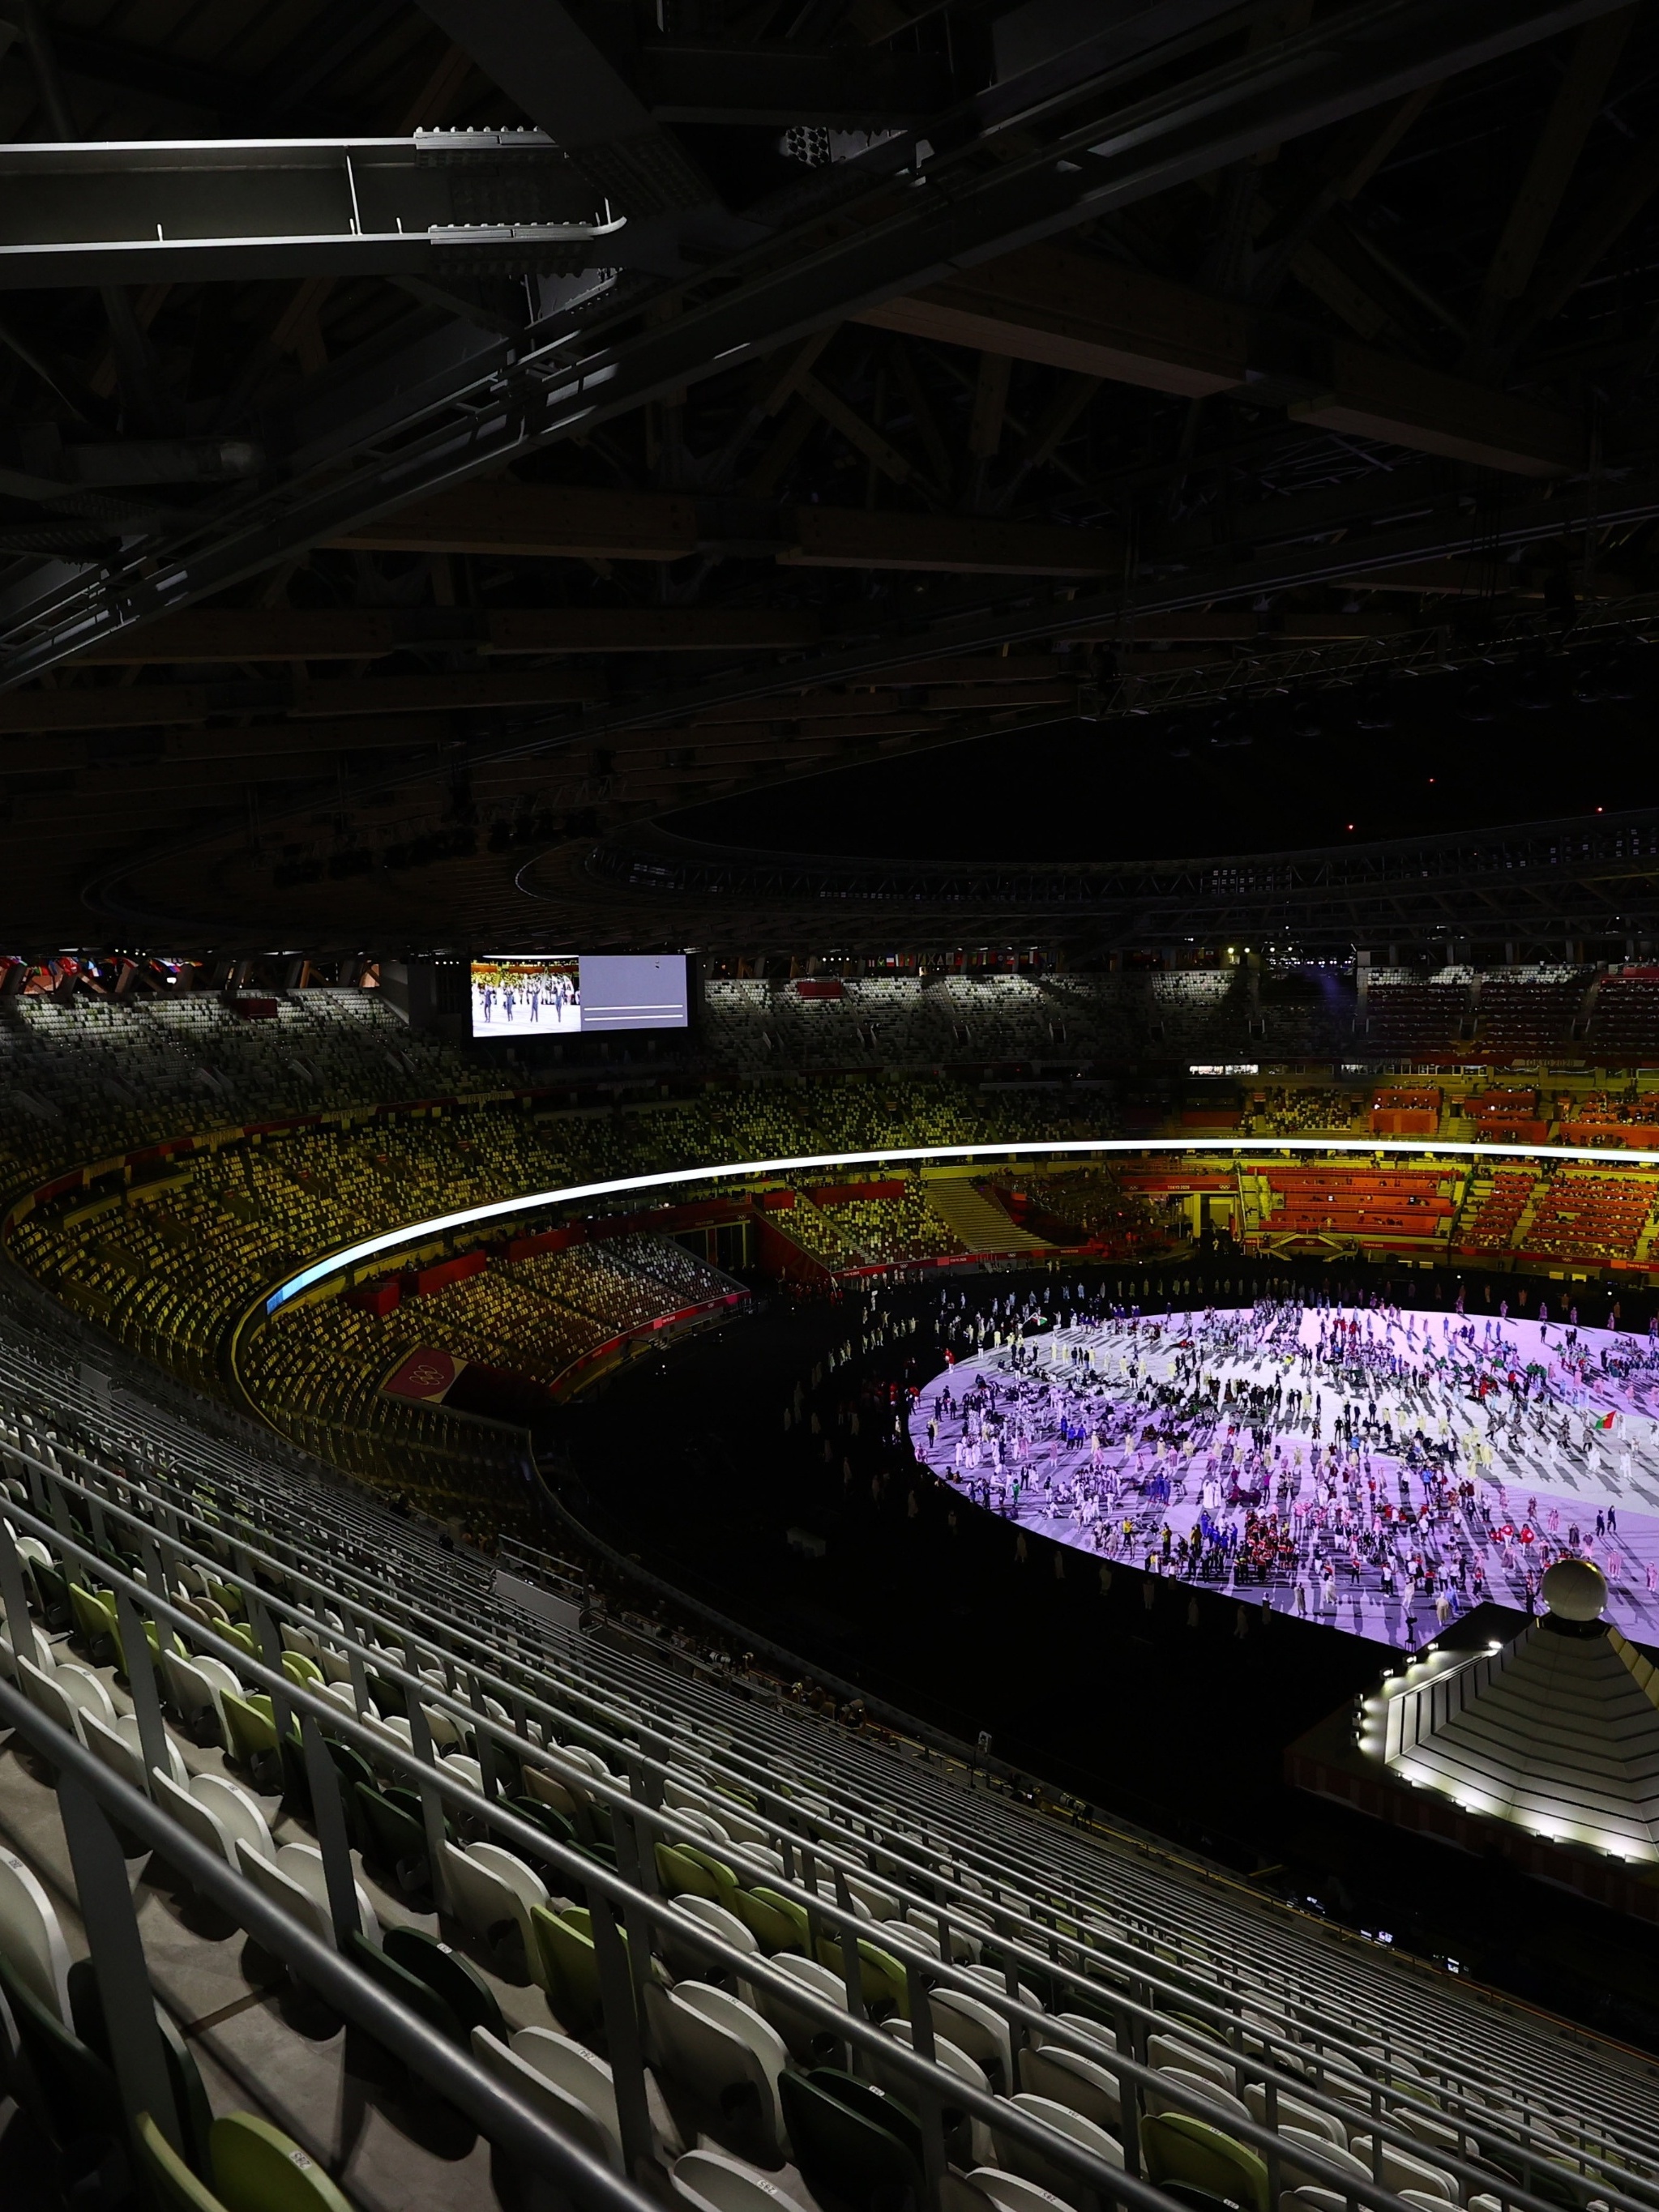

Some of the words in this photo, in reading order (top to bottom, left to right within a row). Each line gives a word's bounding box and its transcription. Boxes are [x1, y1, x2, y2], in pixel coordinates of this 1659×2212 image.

[1524, 1058, 1551, 1067] TOKYO
[1554, 1058, 1574, 1067] 2020
[467, 1094, 489, 1103] TOKYO
[330, 1110, 351, 1121] TOKYO
[353, 1108, 368, 1118] 2020
[759, 2181, 776, 2194] 285
[1042, 2193, 1057, 2202] 285
